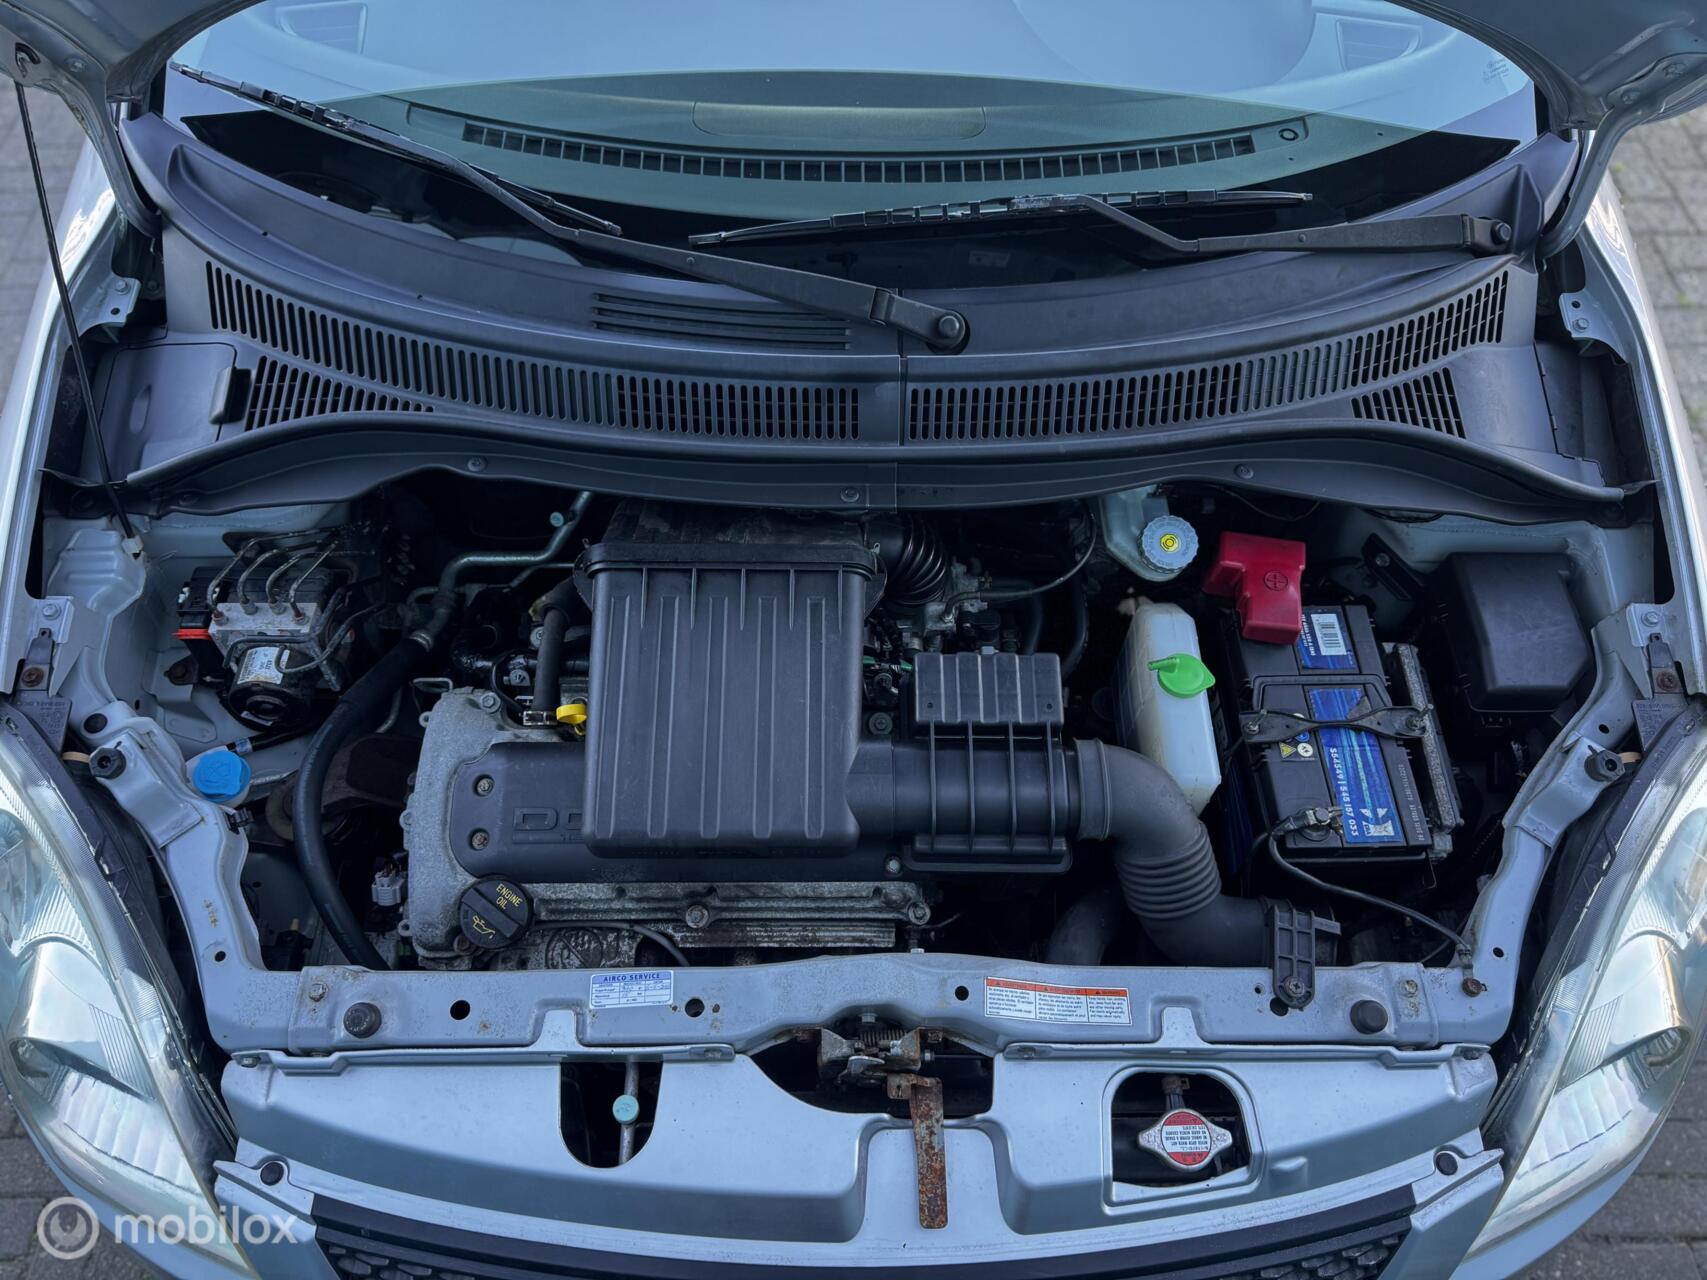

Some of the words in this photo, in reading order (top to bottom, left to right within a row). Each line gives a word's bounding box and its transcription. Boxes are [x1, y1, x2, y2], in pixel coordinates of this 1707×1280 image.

[496, 883, 523, 907] ENGINE
[496, 896, 508, 910] OIL
[603, 974, 627, 983] AIRCO
[629, 972, 660, 981] SERVICE
